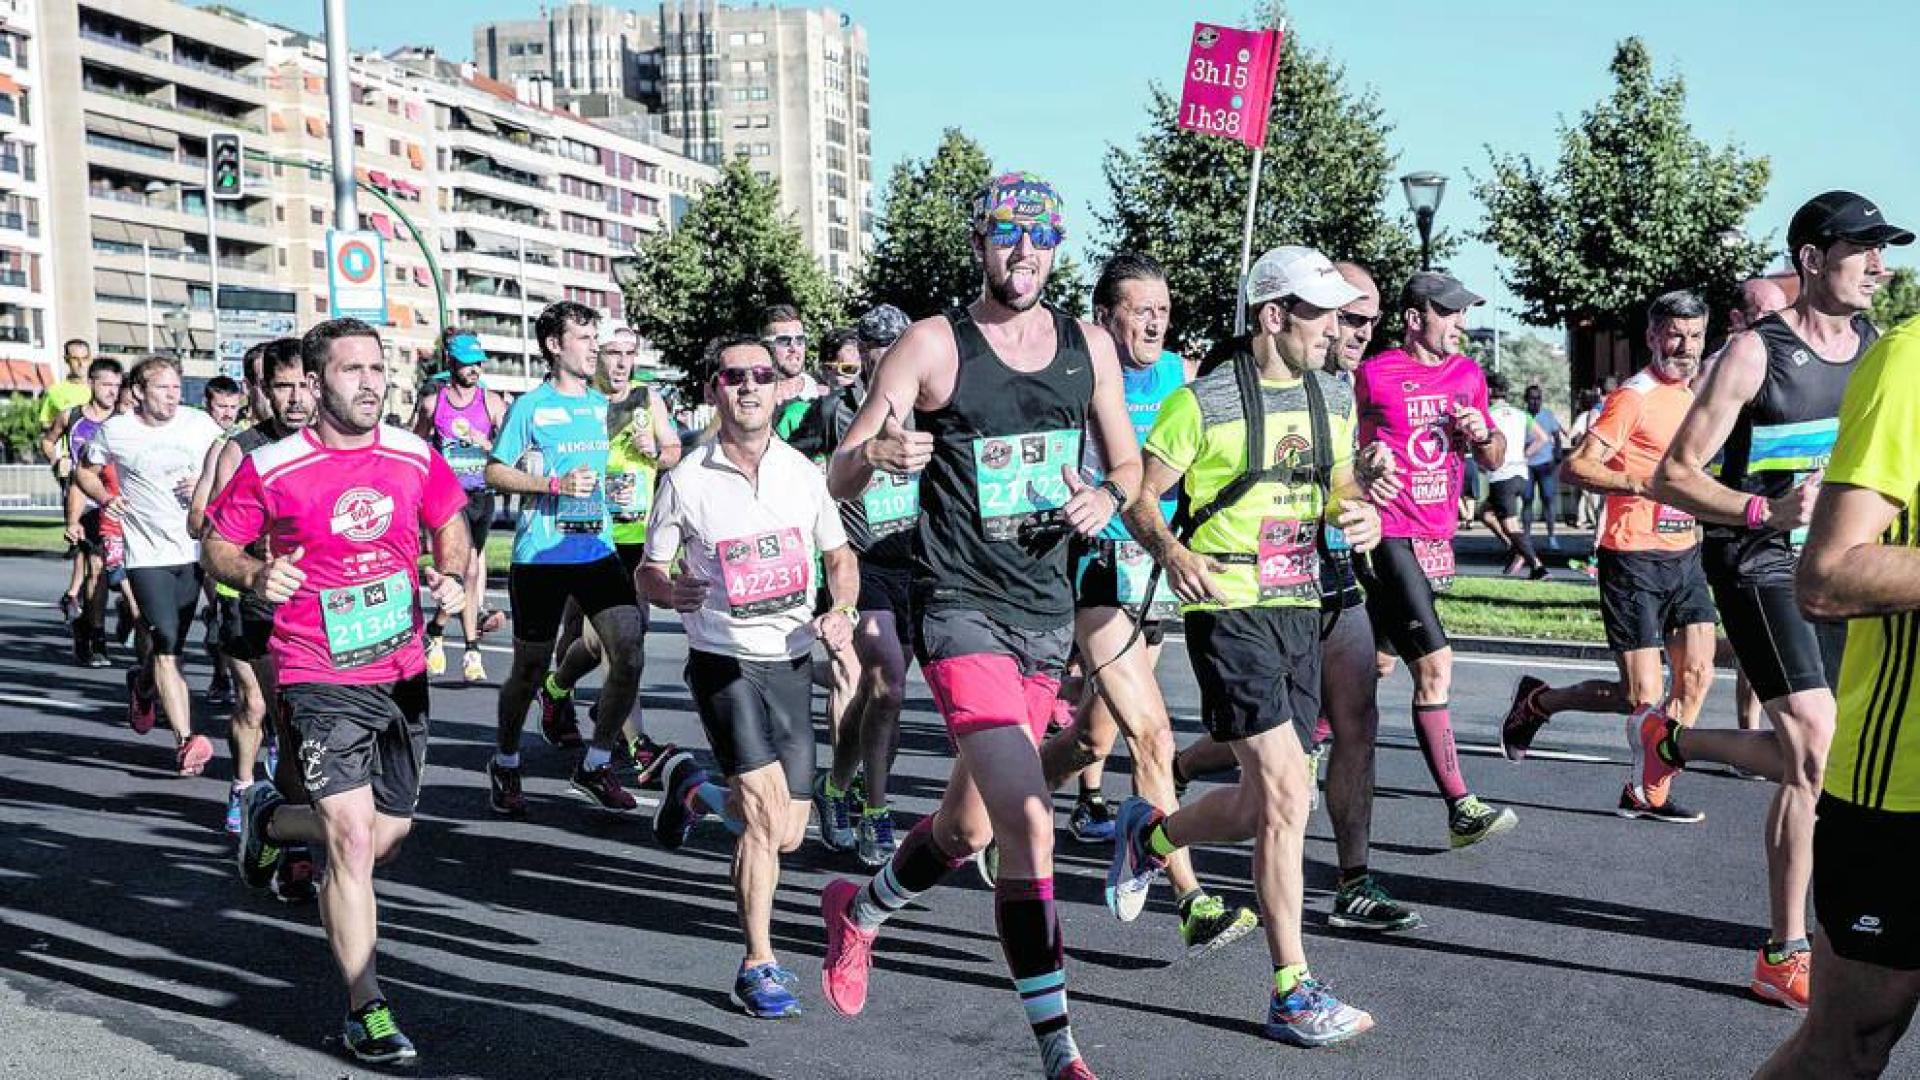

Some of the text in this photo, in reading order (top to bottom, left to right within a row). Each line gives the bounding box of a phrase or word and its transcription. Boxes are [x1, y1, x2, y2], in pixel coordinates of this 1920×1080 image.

[1190, 57, 1249, 89] 3h15
[1186, 102, 1240, 135] 1h38
[1406, 398, 1449, 418] HALF
[729, 563, 804, 597] 42231
